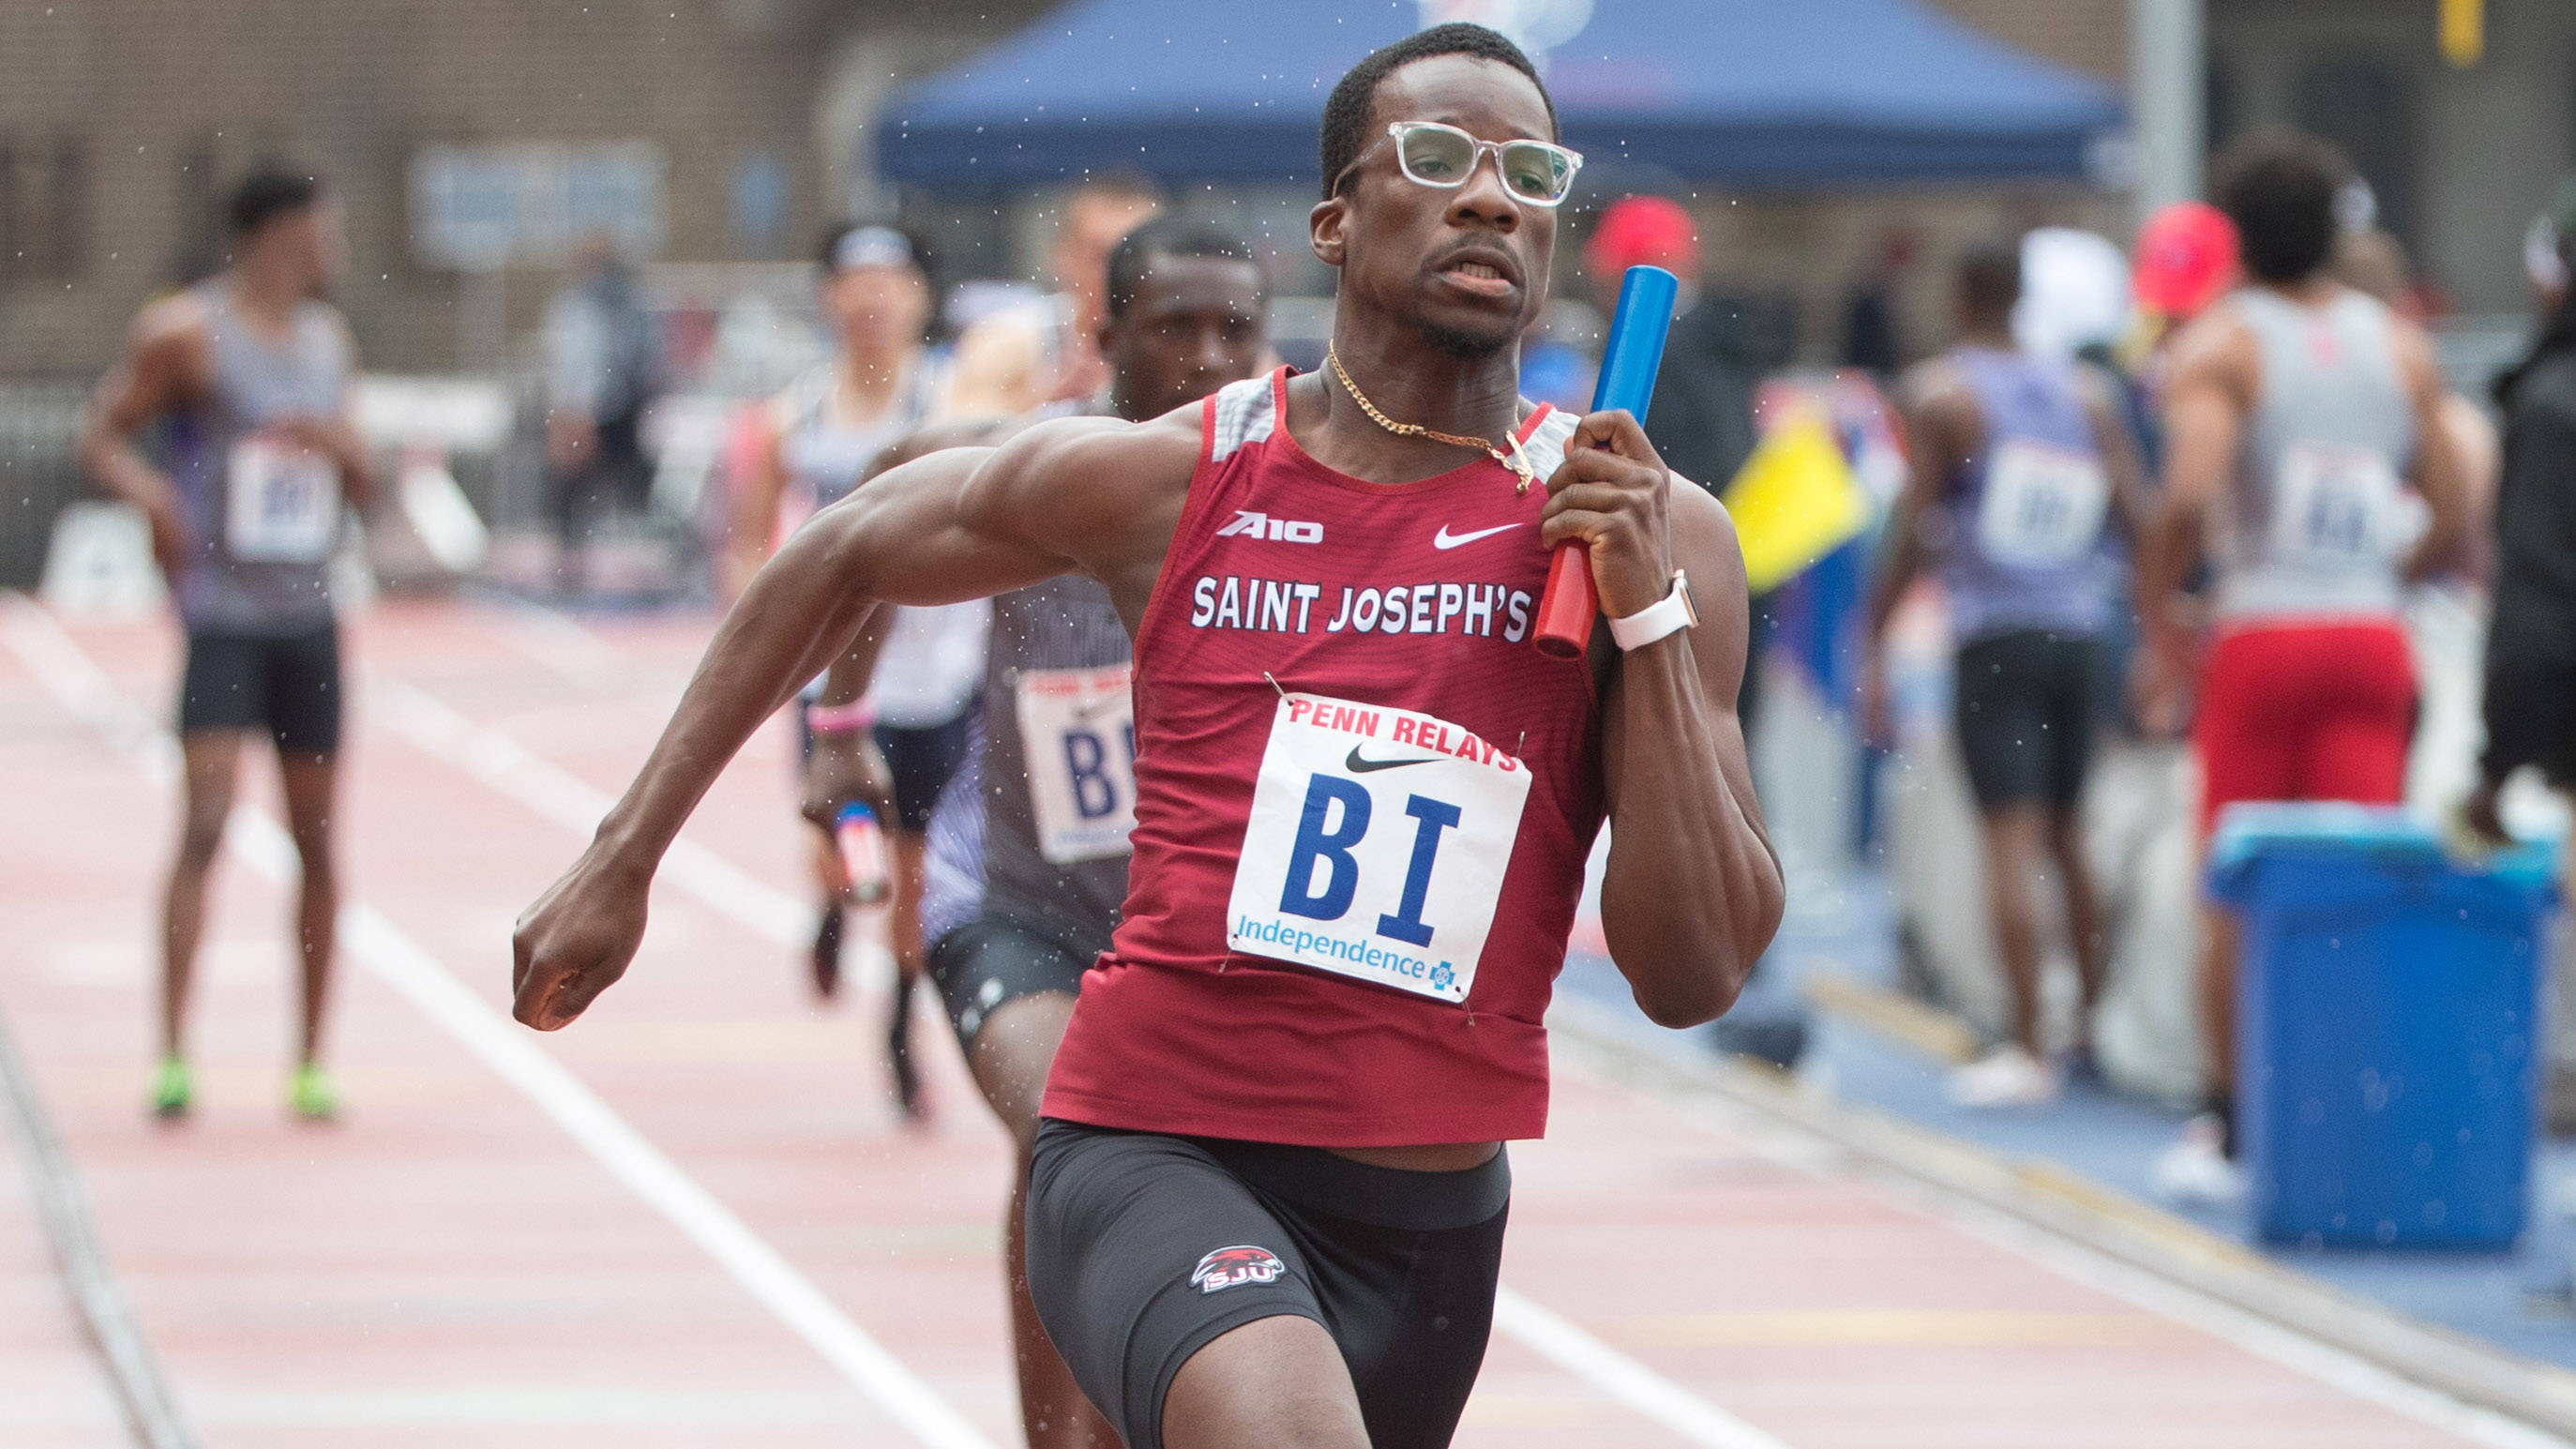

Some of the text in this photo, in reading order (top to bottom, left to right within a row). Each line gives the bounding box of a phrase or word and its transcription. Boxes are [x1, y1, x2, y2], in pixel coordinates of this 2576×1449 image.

[1216, 510, 1324, 544] A10
[1190, 576, 1533, 643] SAINT JOSEPH'S
[1288, 699, 1518, 773] PENN RELAYS
[1238, 913, 1426, 980] Independence
[1207, 1266, 1273, 1289] SJU
